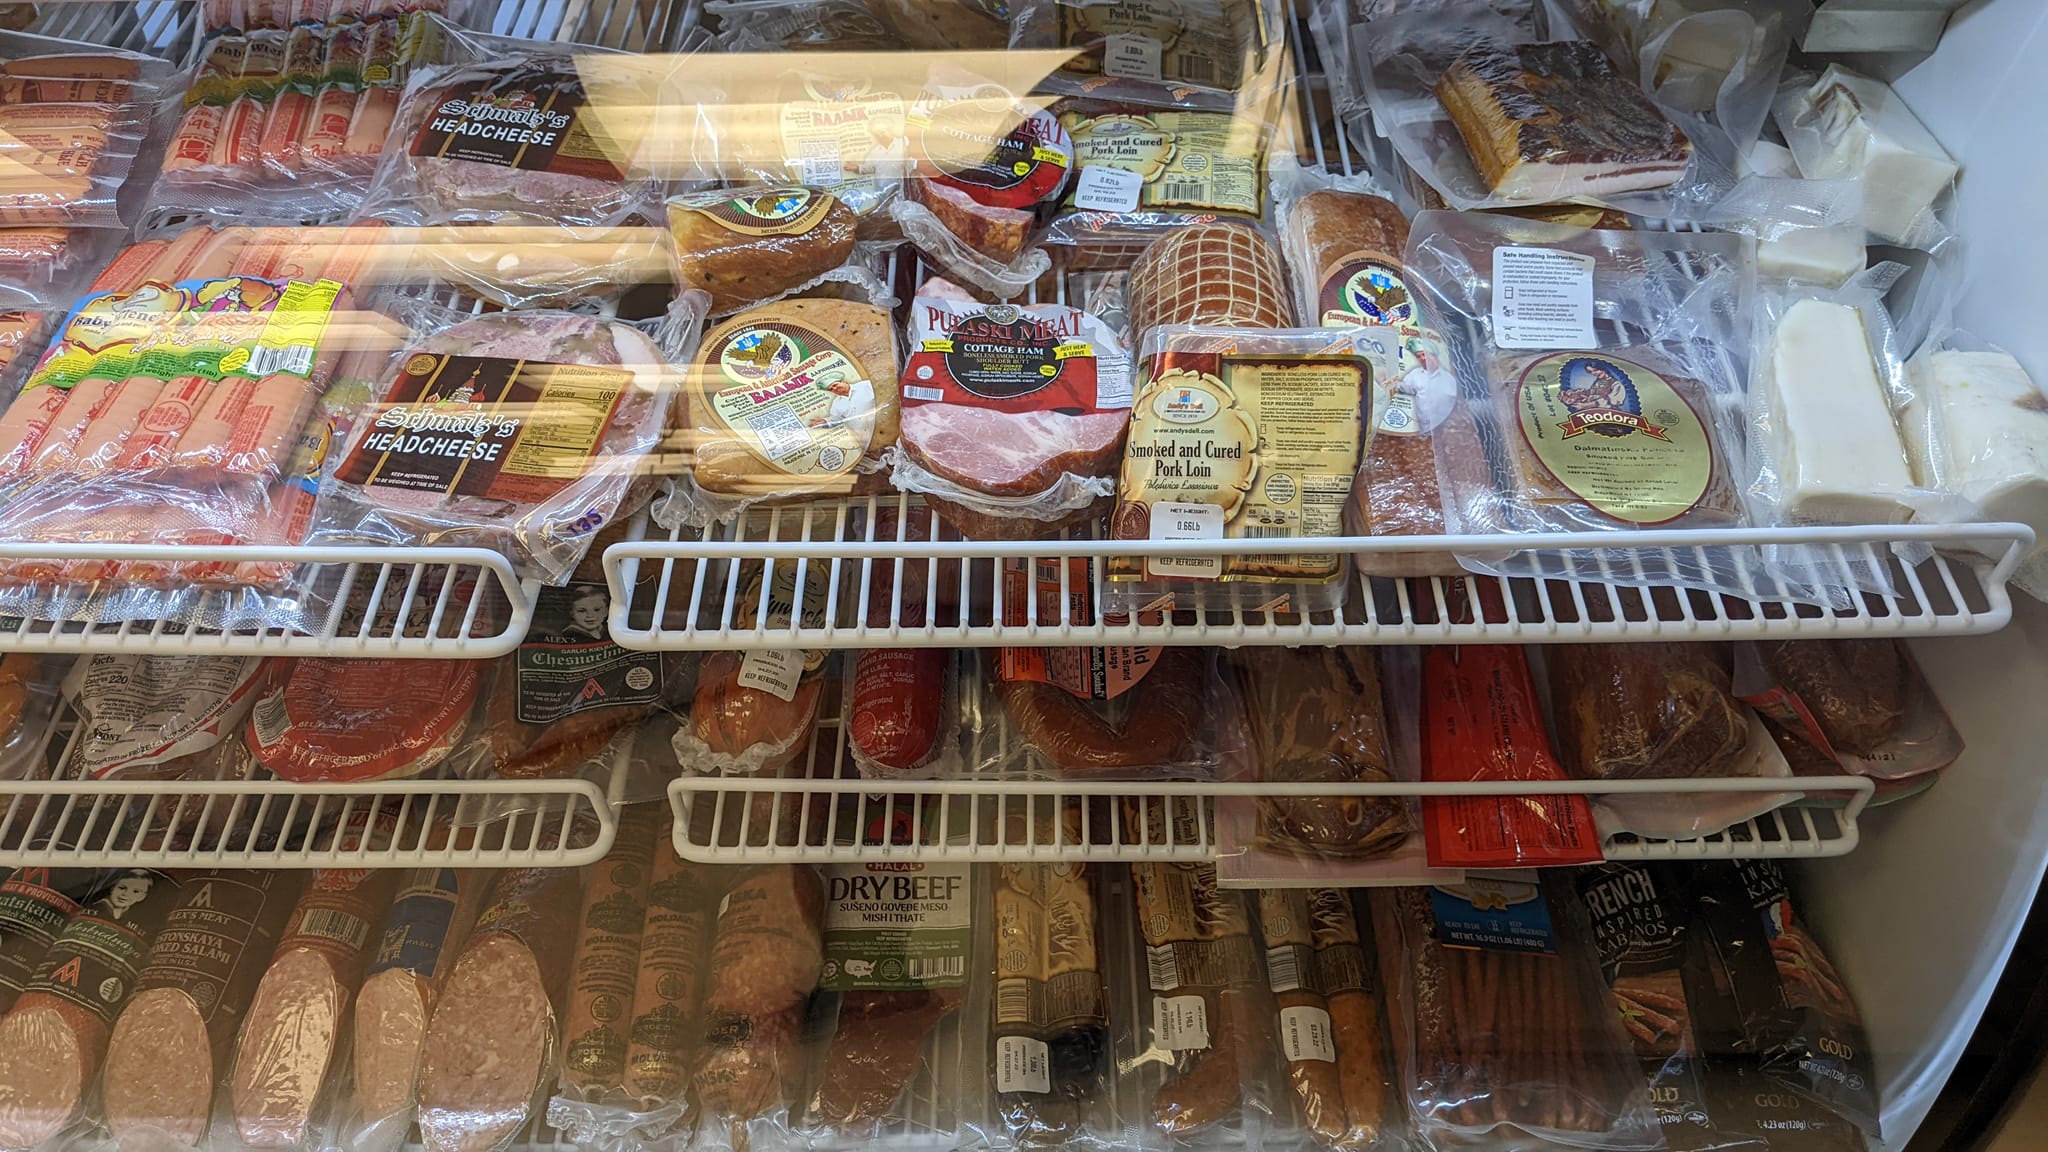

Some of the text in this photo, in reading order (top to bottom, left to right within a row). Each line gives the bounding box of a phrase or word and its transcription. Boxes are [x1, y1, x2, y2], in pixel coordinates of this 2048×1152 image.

[1109, 8, 1130, 19] Pork
[438, 99, 570, 128] Schmalz's
[430, 118, 556, 146] HEADCHEESE
[942, 125, 1024, 151] COTTAGE HAM
[1112, 137, 1163, 147] and Cured
[1091, 146, 1138, 156] Pork Loin
[1518, 252, 1545, 260] Handling
[927, 306, 1085, 340] PULASKI MEAT
[957, 335, 1008, 346] PRODUCTS
[964, 343, 1044, 355] COTTAGE HAM
[1068, 349, 1086, 357] SERVE
[557, 367, 598, 377] Nutrition
[718, 385, 753, 398] European
[790, 360, 817, 376] Sausage
[816, 351, 834, 362] Corp.
[545, 389, 616, 400] Calories 100
[375, 406, 521, 438] Schmalz's
[1578, 411, 1639, 426] Teodora
[362, 432, 502, 462] HEADCHEESE
[1129, 441, 1241, 459] Smoked and Cured
[1155, 460, 1211, 477] Pork Loin
[404, 473, 439, 481] REFRIGERATED
[435, 482, 449, 490] SALE
[1159, 557, 1214, 568] KEEP REFRIGERATED
[543, 635, 577, 644] ALEX'S
[878, 652, 914, 662] SAUSAGE
[1122, 659, 1132, 681] Brand
[109, 675, 128, 684] 220
[744, 672, 789, 691] KEEP REFRIGERATED
[420, 751, 440, 769] OPEN
[875, 862, 917, 871] HALAL
[830, 875, 962, 901] DRY BEEF
[25, 887, 73, 913] PROVISIONS
[1585, 868, 1657, 921] RENCH
[840, 901, 948, 912] SUŠENO MESO
[198, 911, 231, 926] MEAT
[862, 913, 888, 922] MISH
[893, 913, 926, 923] THATE
[1508, 920, 1523, 928] KEEP
[1596, 904, 1663, 939] NSPIRED
[1450, 931, 1463, 940] NET
[1464, 932, 1475, 941] WT.
[1475, 934, 1489, 942] 16.9
[1510, 928, 1549, 937] REFRIGERATED
[181, 942, 232, 964] SALAMI
[1819, 1036, 1853, 1061] GOLD
[1799, 1060, 1812, 1072] NET
[1649, 1087, 1680, 1102] OLD
[1755, 1094, 1800, 1110] GOLD
[1660, 1113, 1684, 1125] (120g)
[1762, 1119, 1807, 1131] 4.23 oz (120g)
